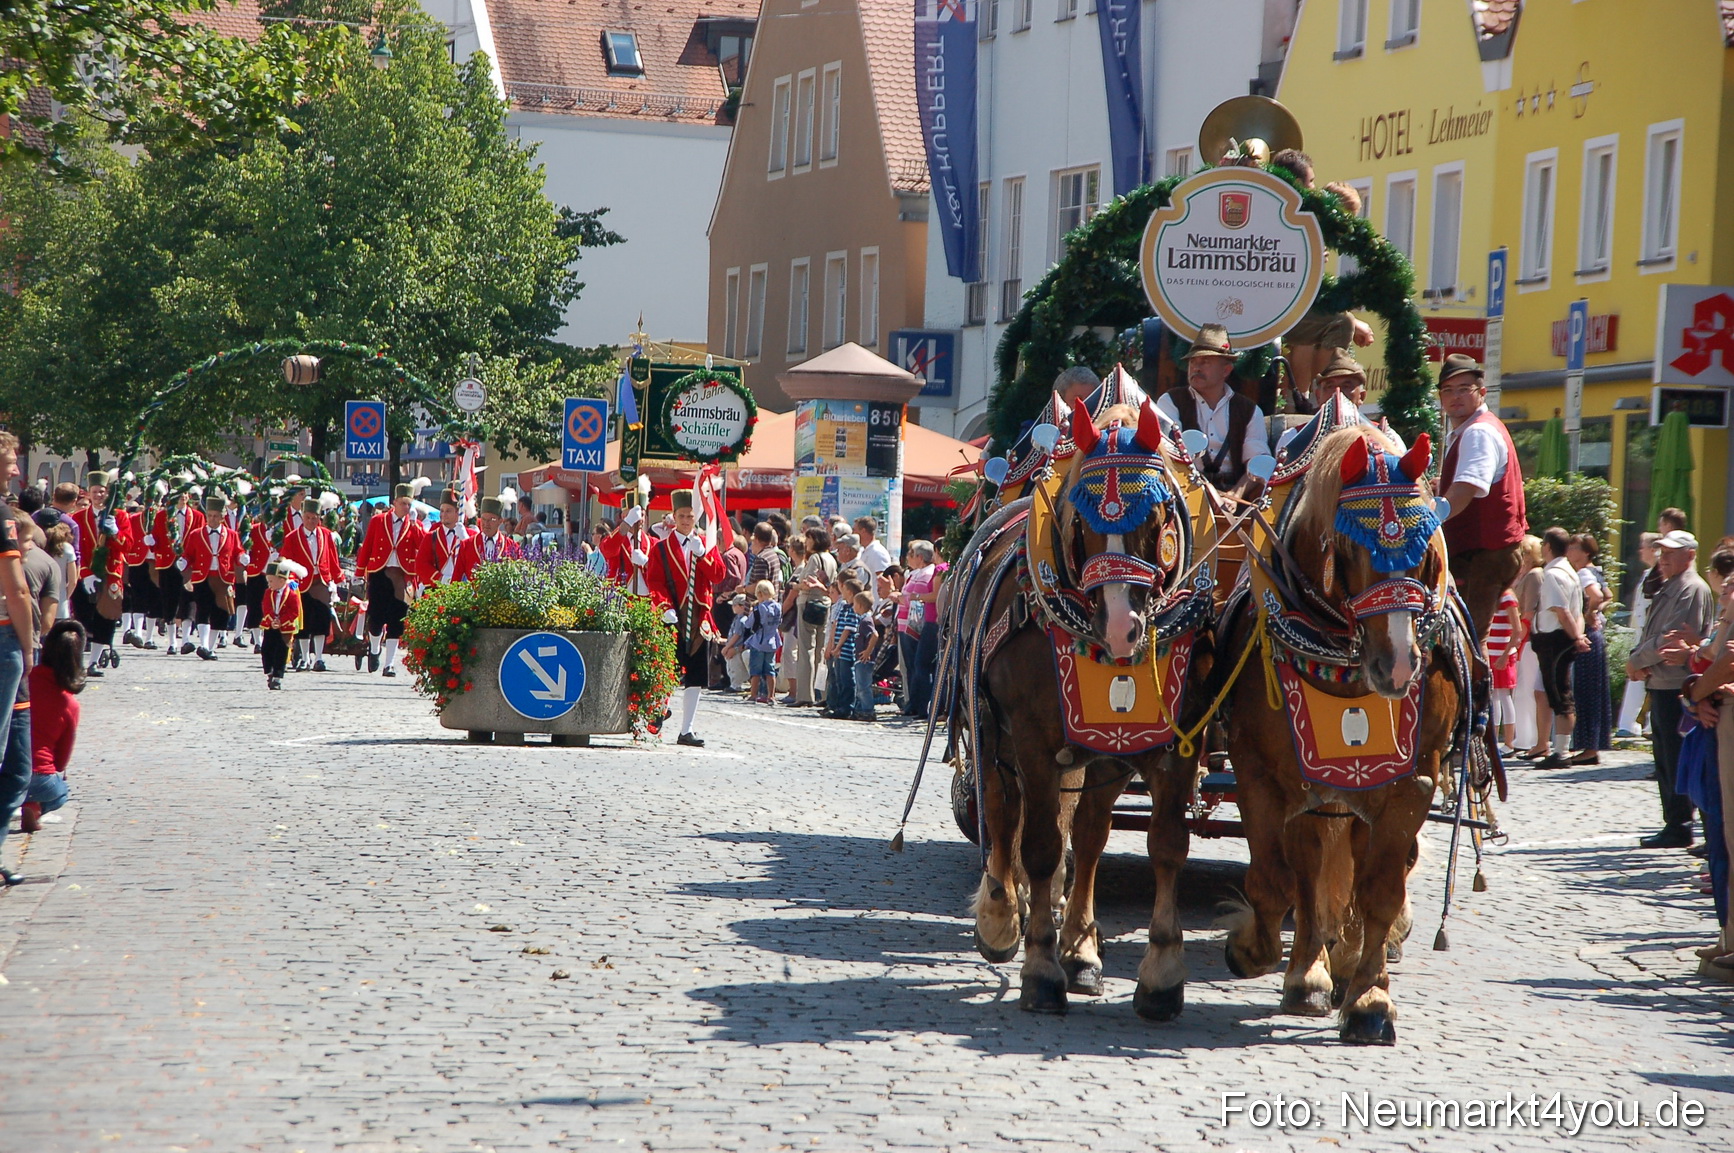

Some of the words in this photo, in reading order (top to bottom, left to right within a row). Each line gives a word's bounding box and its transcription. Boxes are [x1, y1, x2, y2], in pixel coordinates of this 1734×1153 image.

[1360, 109, 1413, 161] HOTEL
[1428, 100, 1494, 145] Lehmeier
[1187, 233, 1281, 251] Neumarkter
[1168, 248, 1296, 273] Lammsbräu
[1212, 278, 1274, 288] ÖKOLOGISCHE
[1491, 259, 1504, 308] P
[1570, 311, 1583, 361] P
[685, 392, 699, 406] 20
[701, 385, 726, 401] Jahre
[673, 406, 741, 421] Lammsbräu
[681, 421, 731, 437] Schäffler
[350, 442, 381, 455] TAXI
[685, 436, 726, 449] Tanzgruppe
[566, 448, 601, 466] TAXI
[914, 483, 938, 493] Hotel
